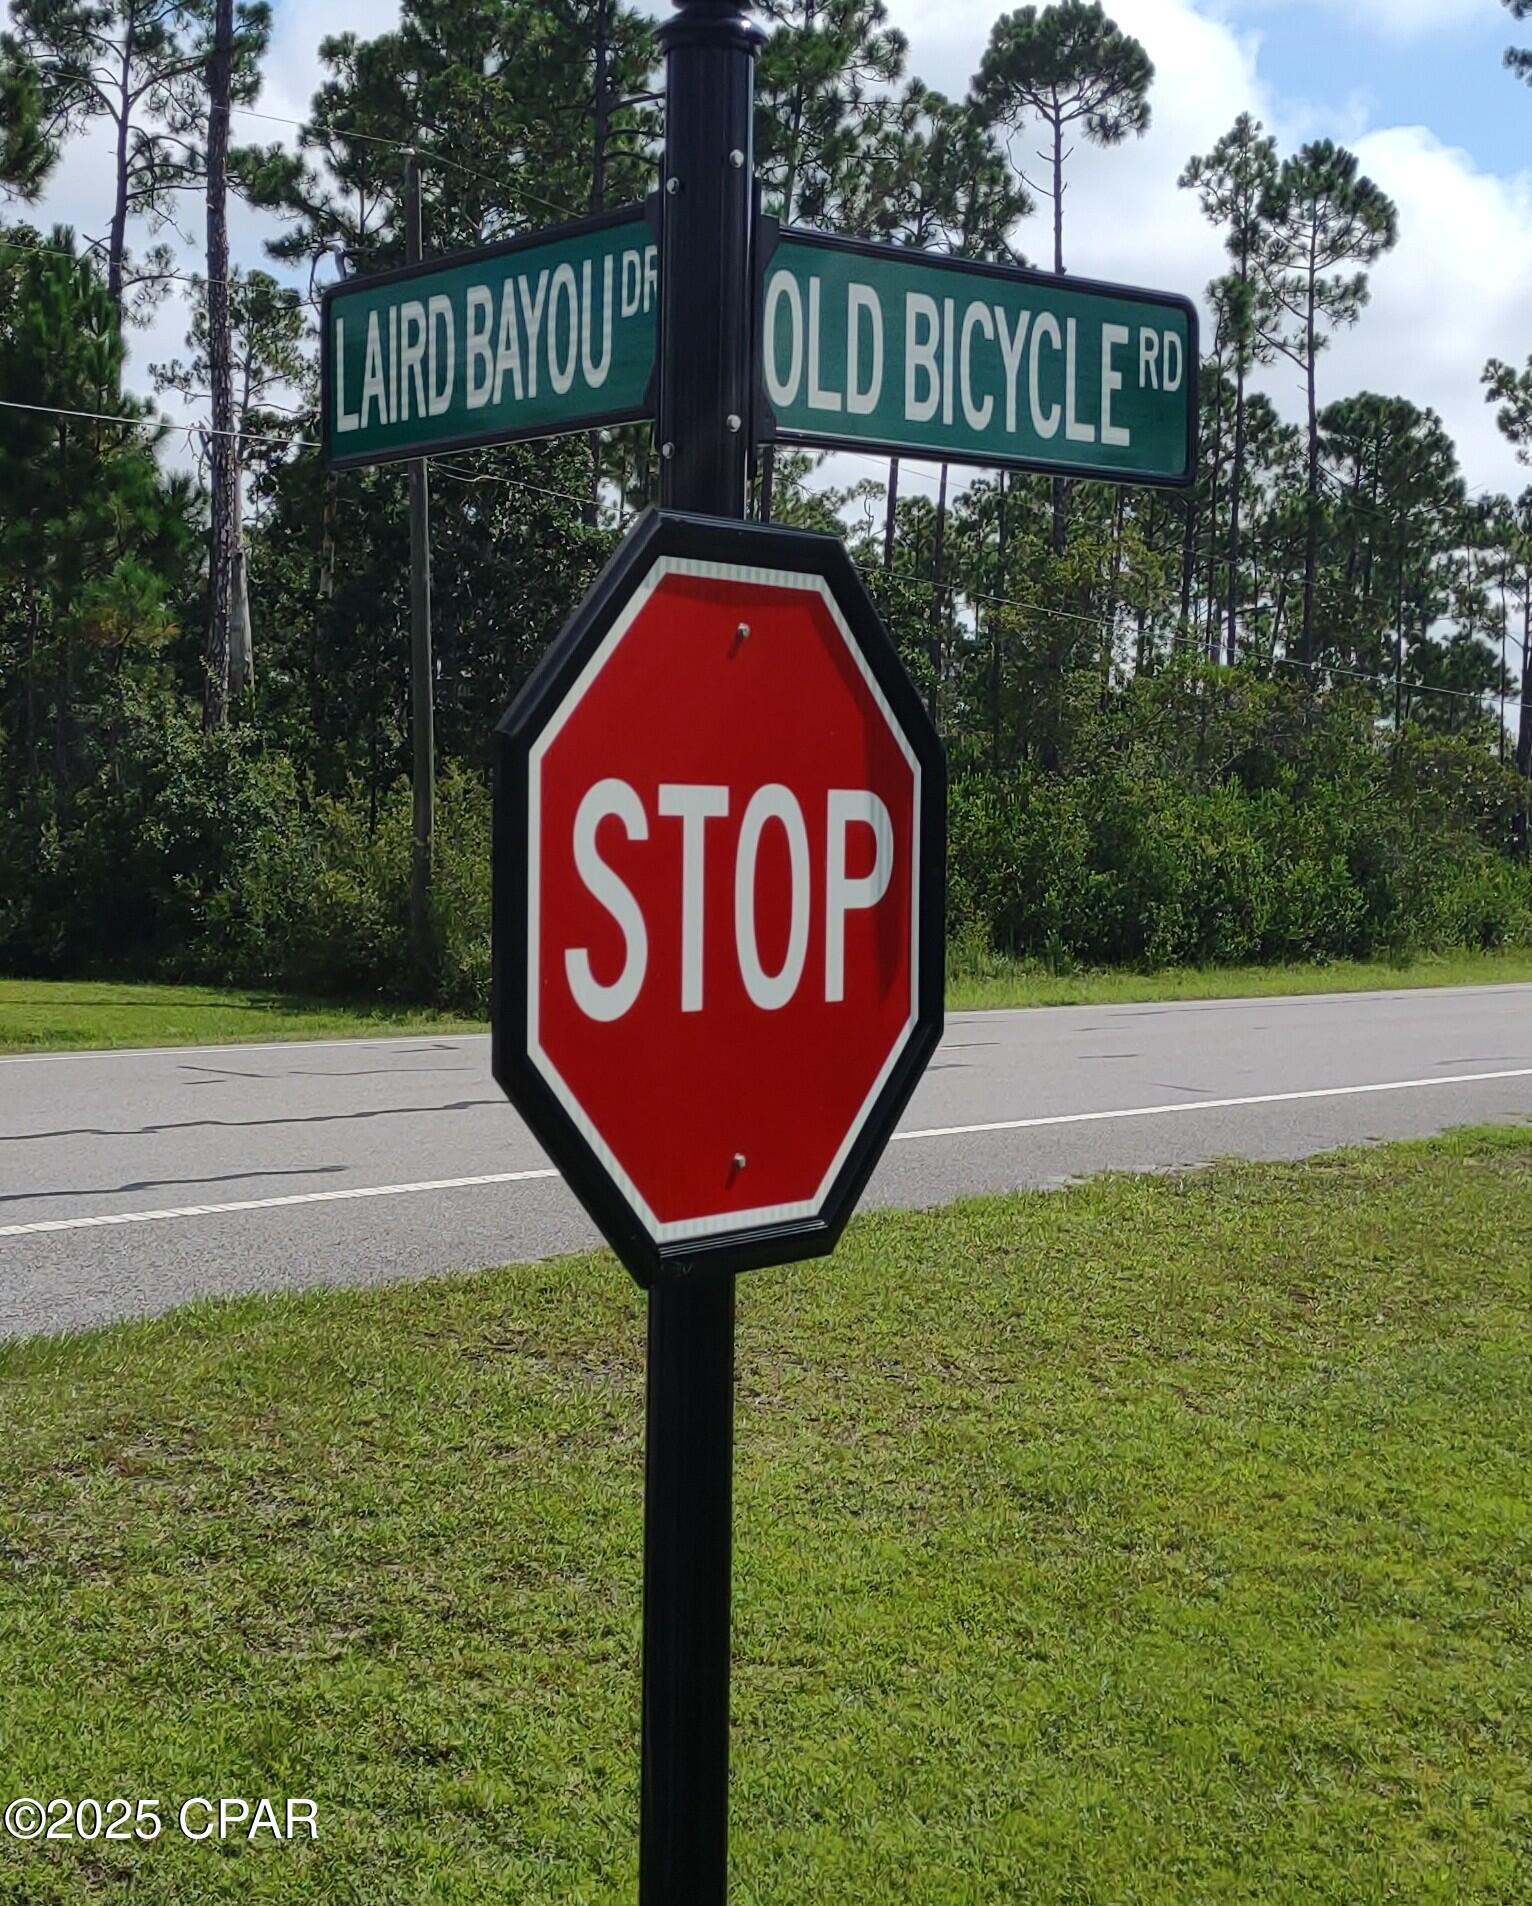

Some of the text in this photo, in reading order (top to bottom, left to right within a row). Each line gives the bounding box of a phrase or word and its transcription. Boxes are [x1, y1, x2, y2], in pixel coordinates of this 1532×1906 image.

[337, 295, 455, 432] LAIRD
[466, 254, 613, 409] BAYOU
[763, 269, 1182, 446] OLD BICYCLE RD
[565, 778, 894, 1022] STOP
